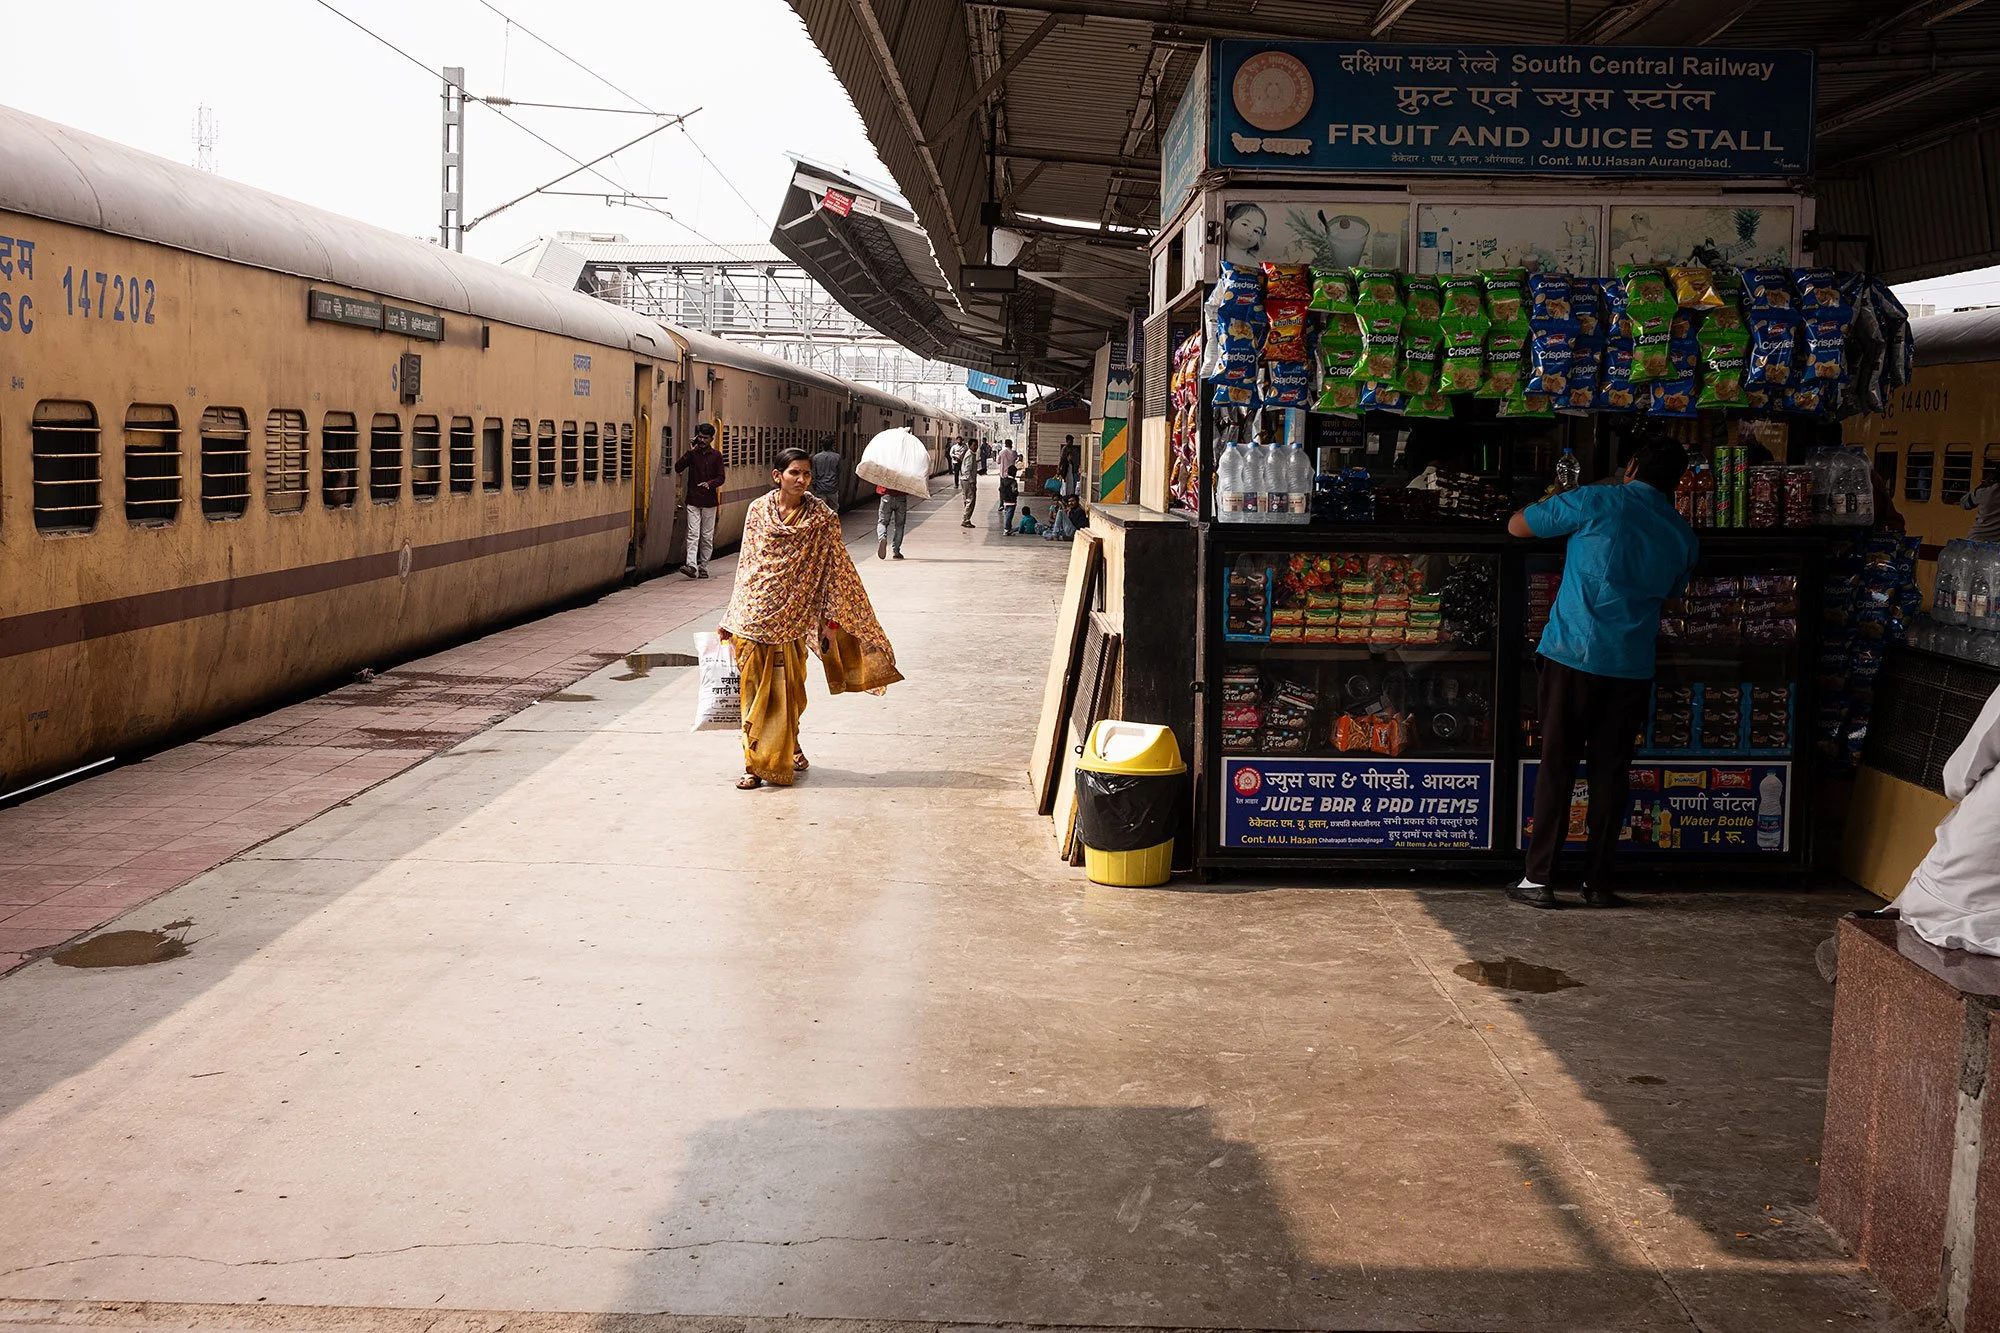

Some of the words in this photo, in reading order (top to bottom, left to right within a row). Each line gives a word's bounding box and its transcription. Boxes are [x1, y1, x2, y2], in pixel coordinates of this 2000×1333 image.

[1340, 49, 1401, 74] दक्षिण
[1409, 55, 1453, 73] मध्य
[1457, 49, 1499, 74] रेल्वे
[1511, 54, 1581, 74] South
[1590, 55, 1674, 75] Central
[1682, 57, 1775, 81] Railway
[1393, 86, 1457, 114] फ्रुट
[1466, 81, 1523, 115] एवं
[1532, 88, 1615, 117] ज्युस
[1624, 83, 1716, 111] स्टॉल
[1328, 124, 1439, 145] FRUIT
[1448, 125, 1530, 148] AND
[1542, 127, 1652, 149] JUICE
[1665, 129, 1784, 151] STALL
[1538, 154, 1573, 166] Cont.
[1577, 156, 1645, 168] M.U.Hasan
[1649, 156, 1731, 170] Aurangabad.
[63, 266, 156, 325] 147202
[0, 292, 33, 334] SC
[1367, 334, 1399, 343] Crispies
[1638, 334, 1671, 344] Crispies
[1405, 350, 1434, 361] Crispie
[1448, 346, 1483, 356] Crispies
[1487, 351, 1521, 361] Crispies
[1572, 365, 1598, 374] rispies
[1608, 366, 1631, 375] Crisp
[1709, 359, 1744, 370] Crispies
[1329, 366, 1353, 376] Crisp
[1901, 389, 1948, 412] 144001
[1265, 773, 1304, 793] ज्युस
[1307, 773, 1336, 789] बार
[1341, 772, 1357, 789] &
[1361, 768, 1415, 791] पीएडी.
[1421, 774, 1480, 790] आयटम
[1261, 797, 1315, 811] JUICE
[1320, 797, 1356, 812] BAR
[1361, 798, 1372, 812] &
[1377, 798, 1414, 813] PAD
[1419, 799, 1479, 814] ITEMS
[1668, 792, 1709, 811] पाणी
[1712, 793, 1758, 811] बॉटल
[1248, 817, 1278, 828] ठेकेदार:
[1280, 819, 1295, 828] एम.
[1297, 819, 1306, 830] यु.
[1308, 819, 1329, 829] हसन,
[1383, 816, 1401, 825] सभी
[1403, 818, 1425, 826] प्रकार
[1426, 816, 1440, 825] की
[1680, 816, 1715, 827] Water
[1717, 816, 1754, 827] Bottle
[1240, 835, 1265, 844] Cont.
[1268, 835, 1288, 844] M.U.
[1290, 836, 1319, 844] Hasan
[1388, 831, 1401, 841] हुए
[1402, 829, 1421, 839] दामों
[1450, 830, 1467, 839] जाते
[1468, 829, 1478, 840] है.
[1702, 831, 1721, 844] 14
[1725, 831, 1745, 845] रू.
